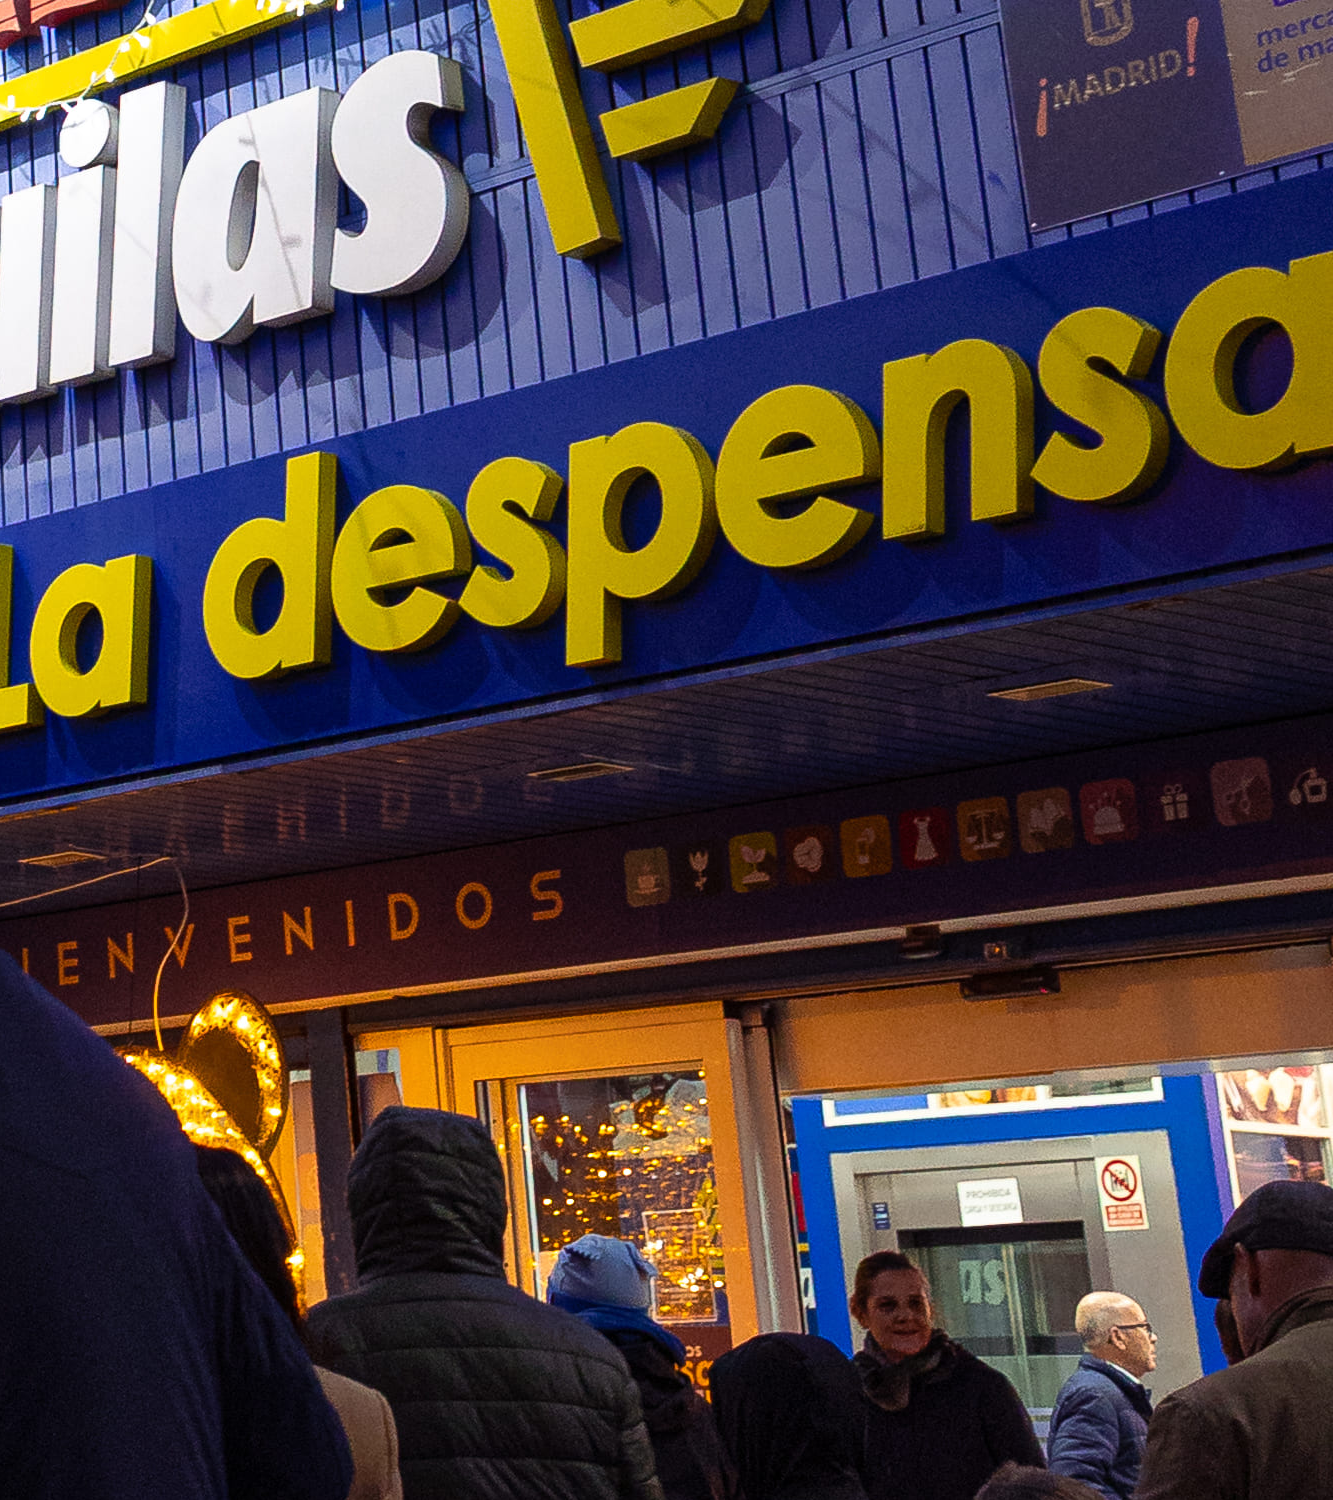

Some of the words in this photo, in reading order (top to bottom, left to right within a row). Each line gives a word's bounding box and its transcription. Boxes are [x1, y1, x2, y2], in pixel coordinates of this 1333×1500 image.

[1036, 16, 1200, 137] ¡MADRID!
[1258, 49, 1290, 73] de
[201, 250, 1333, 668] despensa
[21, 868, 564, 987] IENVENIDOS
